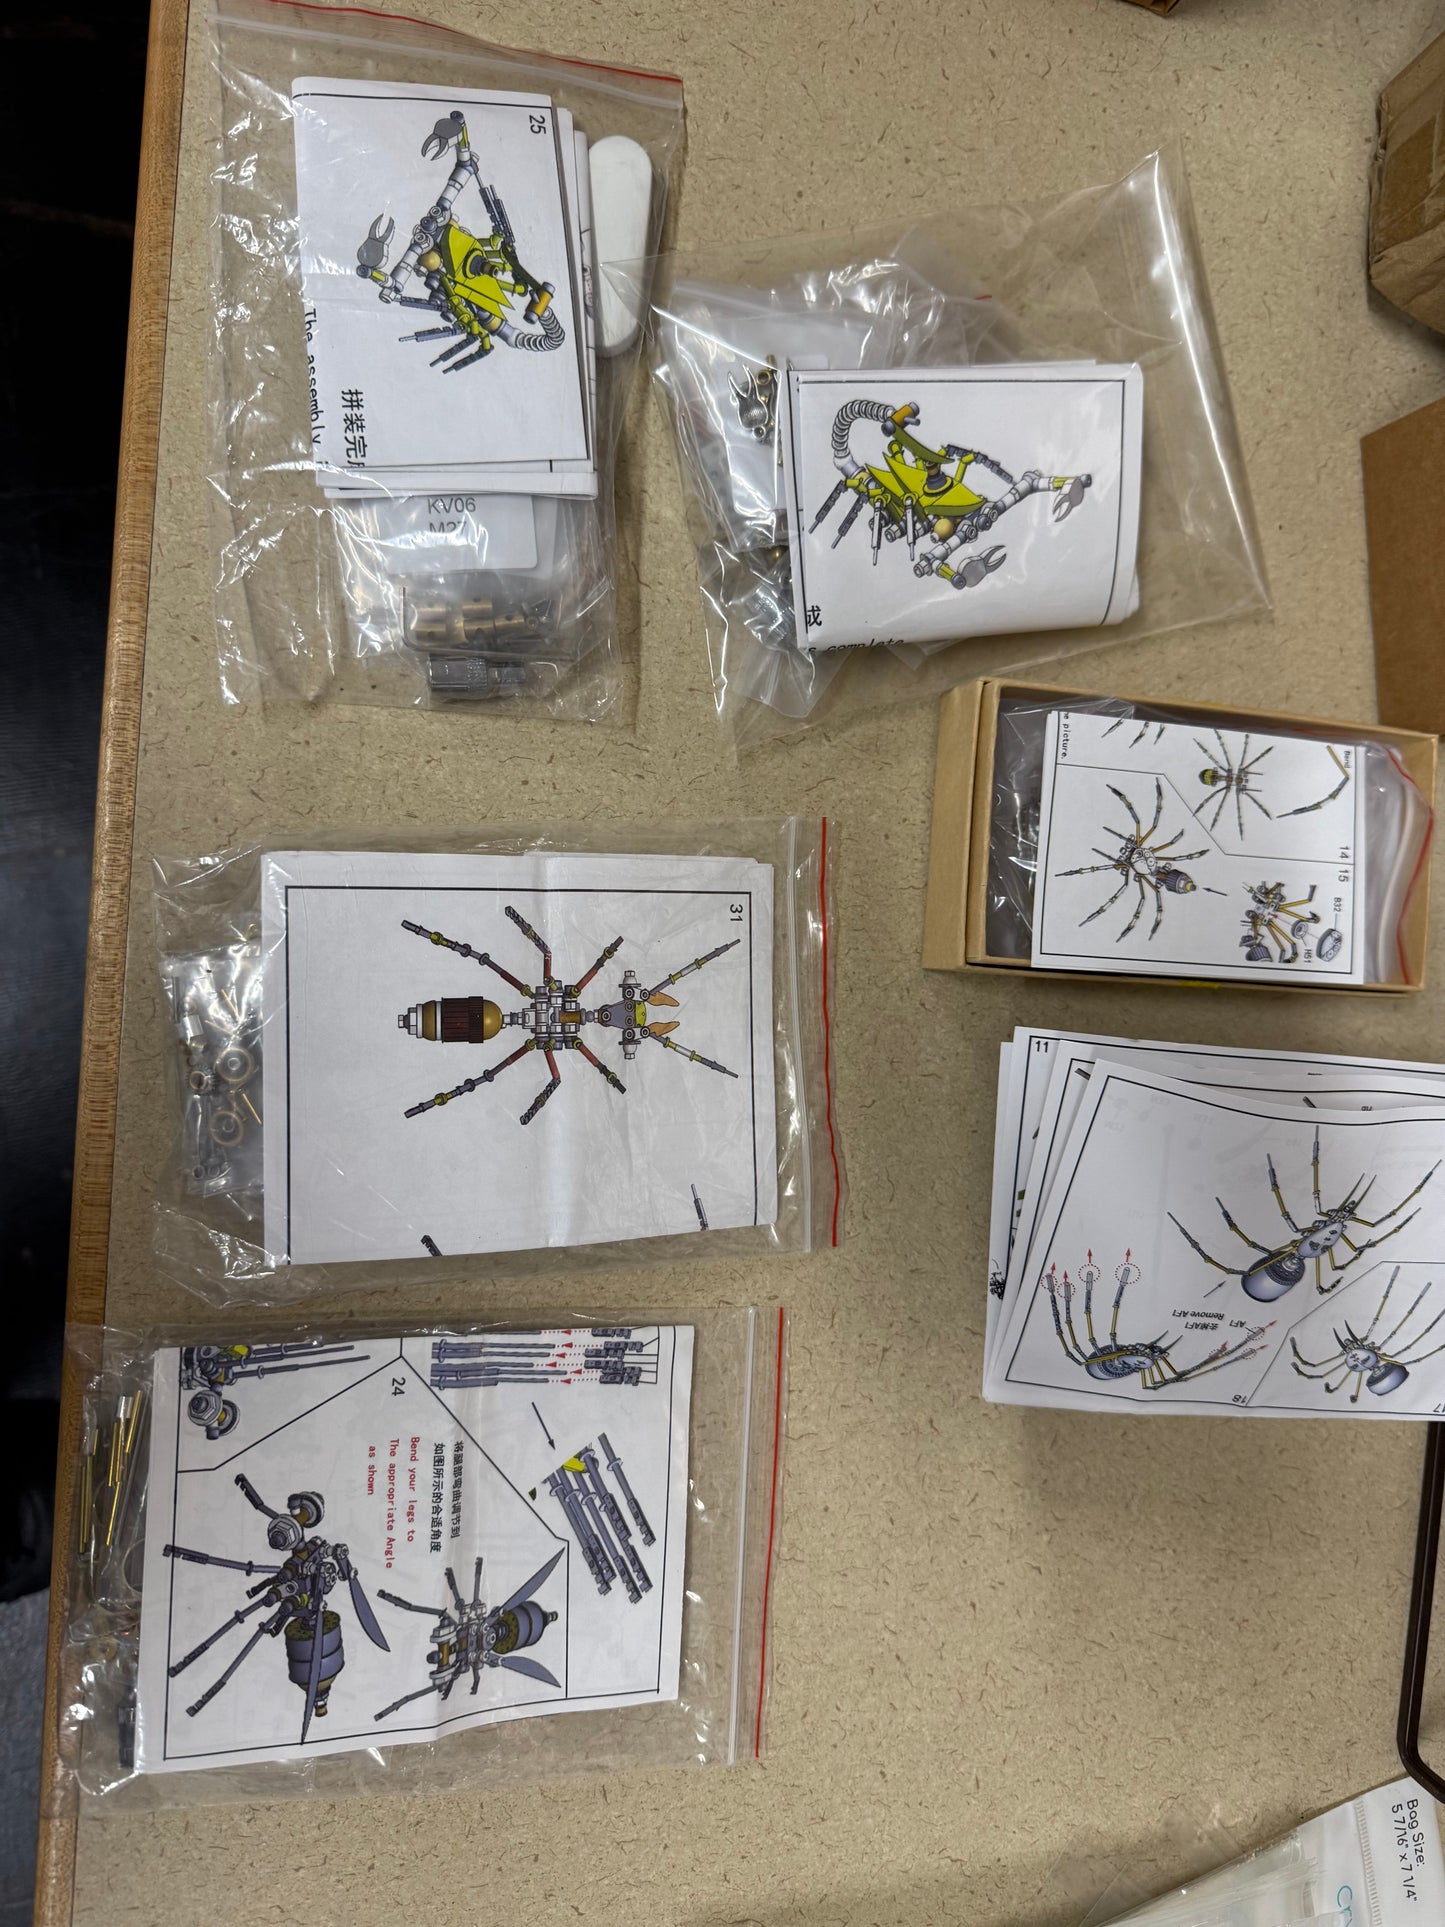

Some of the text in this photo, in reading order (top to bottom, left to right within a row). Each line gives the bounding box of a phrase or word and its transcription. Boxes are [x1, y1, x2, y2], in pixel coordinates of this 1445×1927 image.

[529, 114, 547, 135] 25
[304, 308, 317, 342] The
[427, 497, 477, 514] KV06
[1339, 845, 1350, 860] 14
[1338, 869, 1350, 882] 15
[729, 903, 744, 922] 31
[1035, 1040, 1049, 1053] 11
[1172, 1309, 1225, 1320] Remove AF1
[1229, 1319, 1247, 1329] AF1
[391, 1376, 407, 1397] 24
[1231, 1394, 1248, 1405] 18
[367, 1445, 378, 1496] as shown
[406, 1436, 421, 1543] Bend your legs to
[430, 1442, 446, 1554] 如图所示的合适角度
[384, 1438, 400, 1569] The appropriate Angle
[1406, 1798, 1426, 1867] Bag Size:
[1391, 1803, 1418, 1902] 5 7/16" x 7 1/4"
